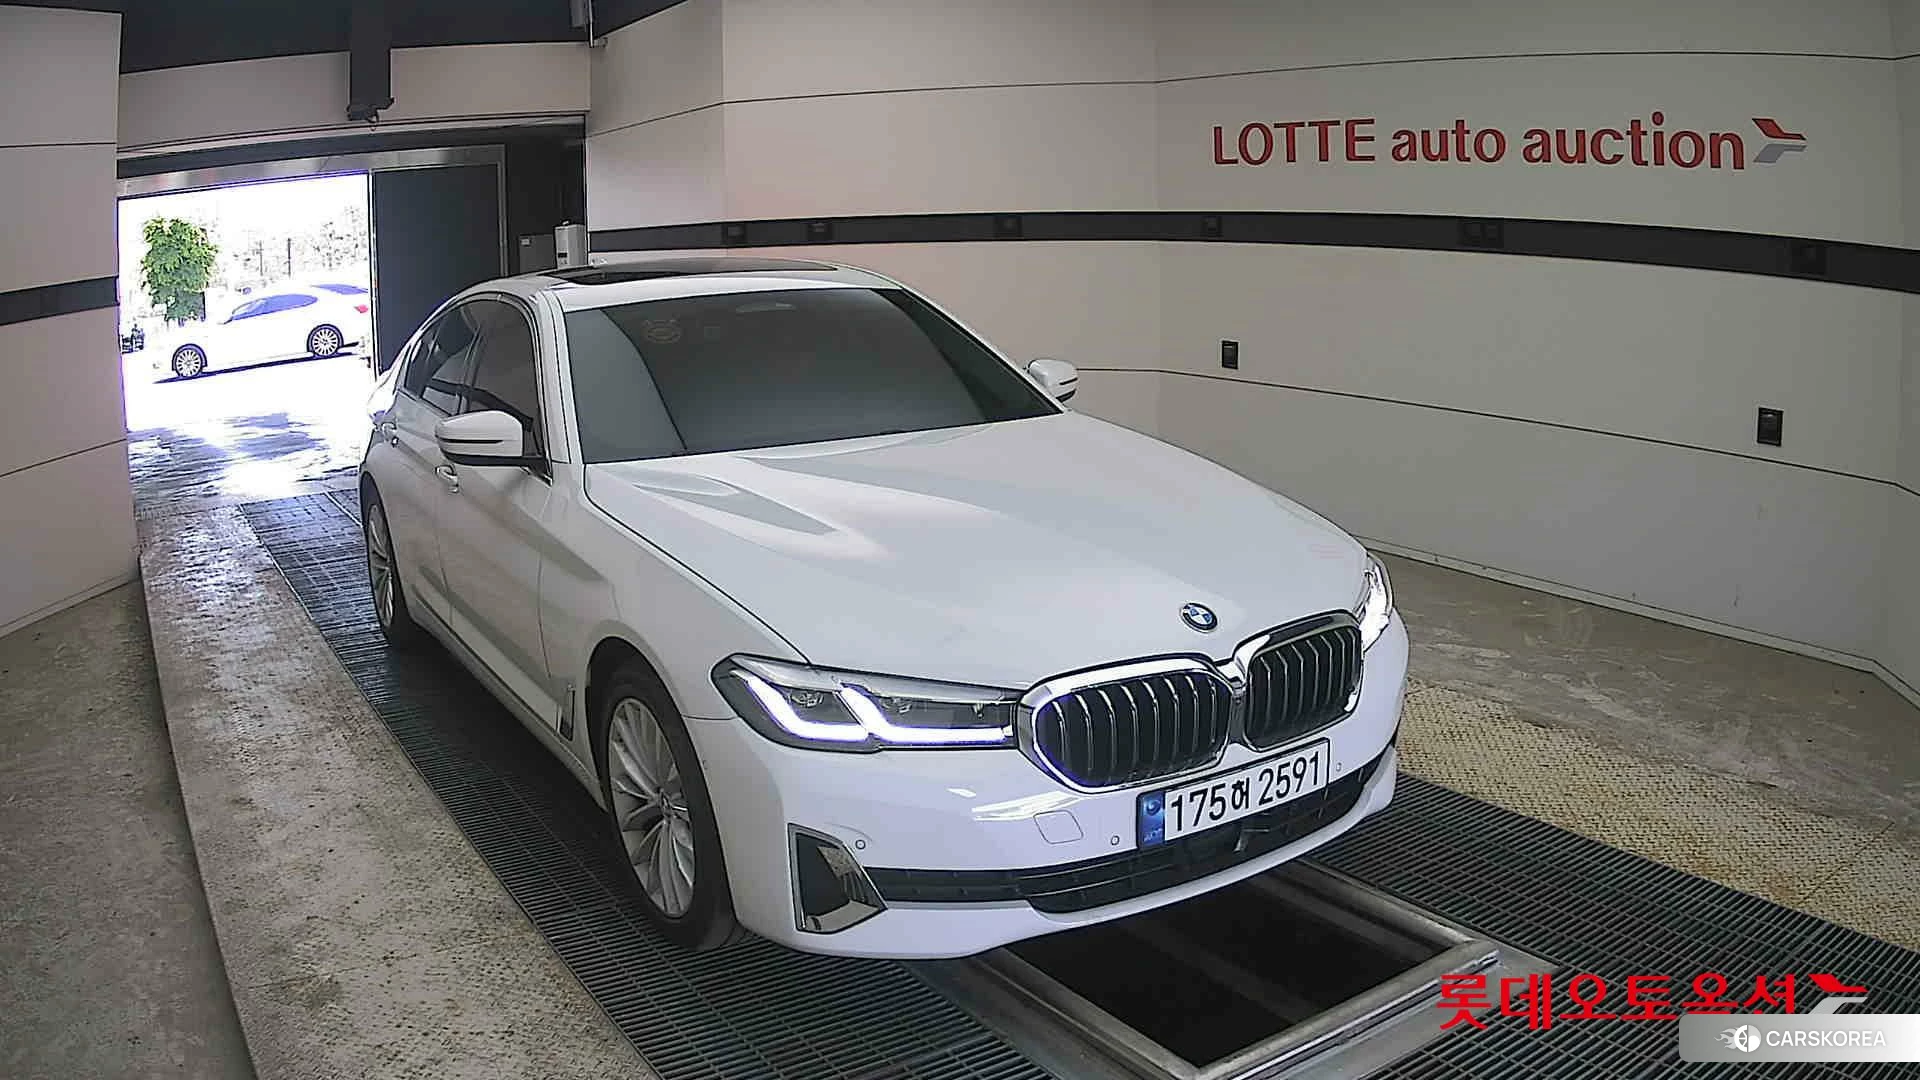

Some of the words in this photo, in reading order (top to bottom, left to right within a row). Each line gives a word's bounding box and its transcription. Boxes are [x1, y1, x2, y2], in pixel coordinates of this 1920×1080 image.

[1213, 118, 1376, 166] LOTTE
[1391, 119, 1506, 163] auto
[1522, 111, 1745, 170] auction
[1171, 777, 1250, 832] 175허
[1258, 751, 1320, 806] 2591
